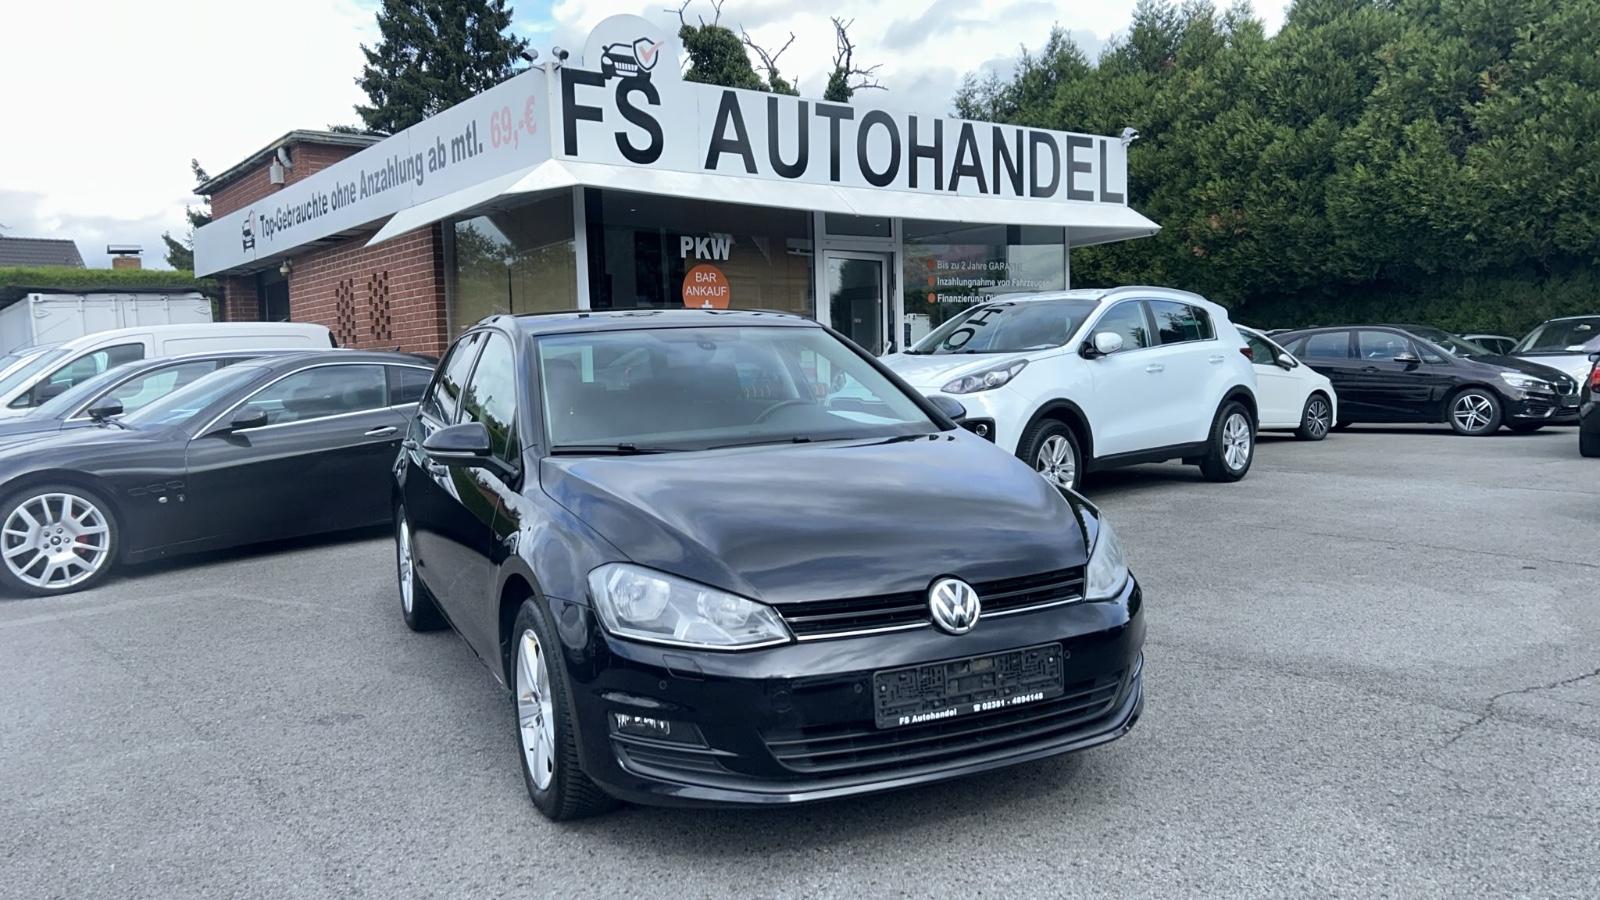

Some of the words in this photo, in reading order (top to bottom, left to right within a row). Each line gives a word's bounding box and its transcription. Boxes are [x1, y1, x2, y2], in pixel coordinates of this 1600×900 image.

[561, 67, 664, 164] FS
[704, 90, 1125, 204] AUTOHANDEL
[259, 189, 328, 241] Top-Gebrauchte
[331, 181, 356, 211] ohne
[360, 152, 424, 200] Anzahlung
[428, 136, 447, 173] ab
[451, 120, 483, 164] mtl.
[490, 95, 537, 149] 69,-€
[680, 236, 731, 260] PKW
[937, 260, 949, 270] Bis
[950, 262, 960, 271] zu
[961, 262, 966, 271] 2
[967, 262, 987, 271] Jahre
[695, 272, 717, 282] BAR
[937, 277, 996, 288] Inzahlungnahme
[998, 279, 1009, 287] von
[685, 286, 727, 297] ANKAUF
[937, 293, 984, 304] Finanzierung
[931, 579, 980, 632] VW
[899, 716, 910, 725] FS
[912, 707, 957, 723] Autohandel
